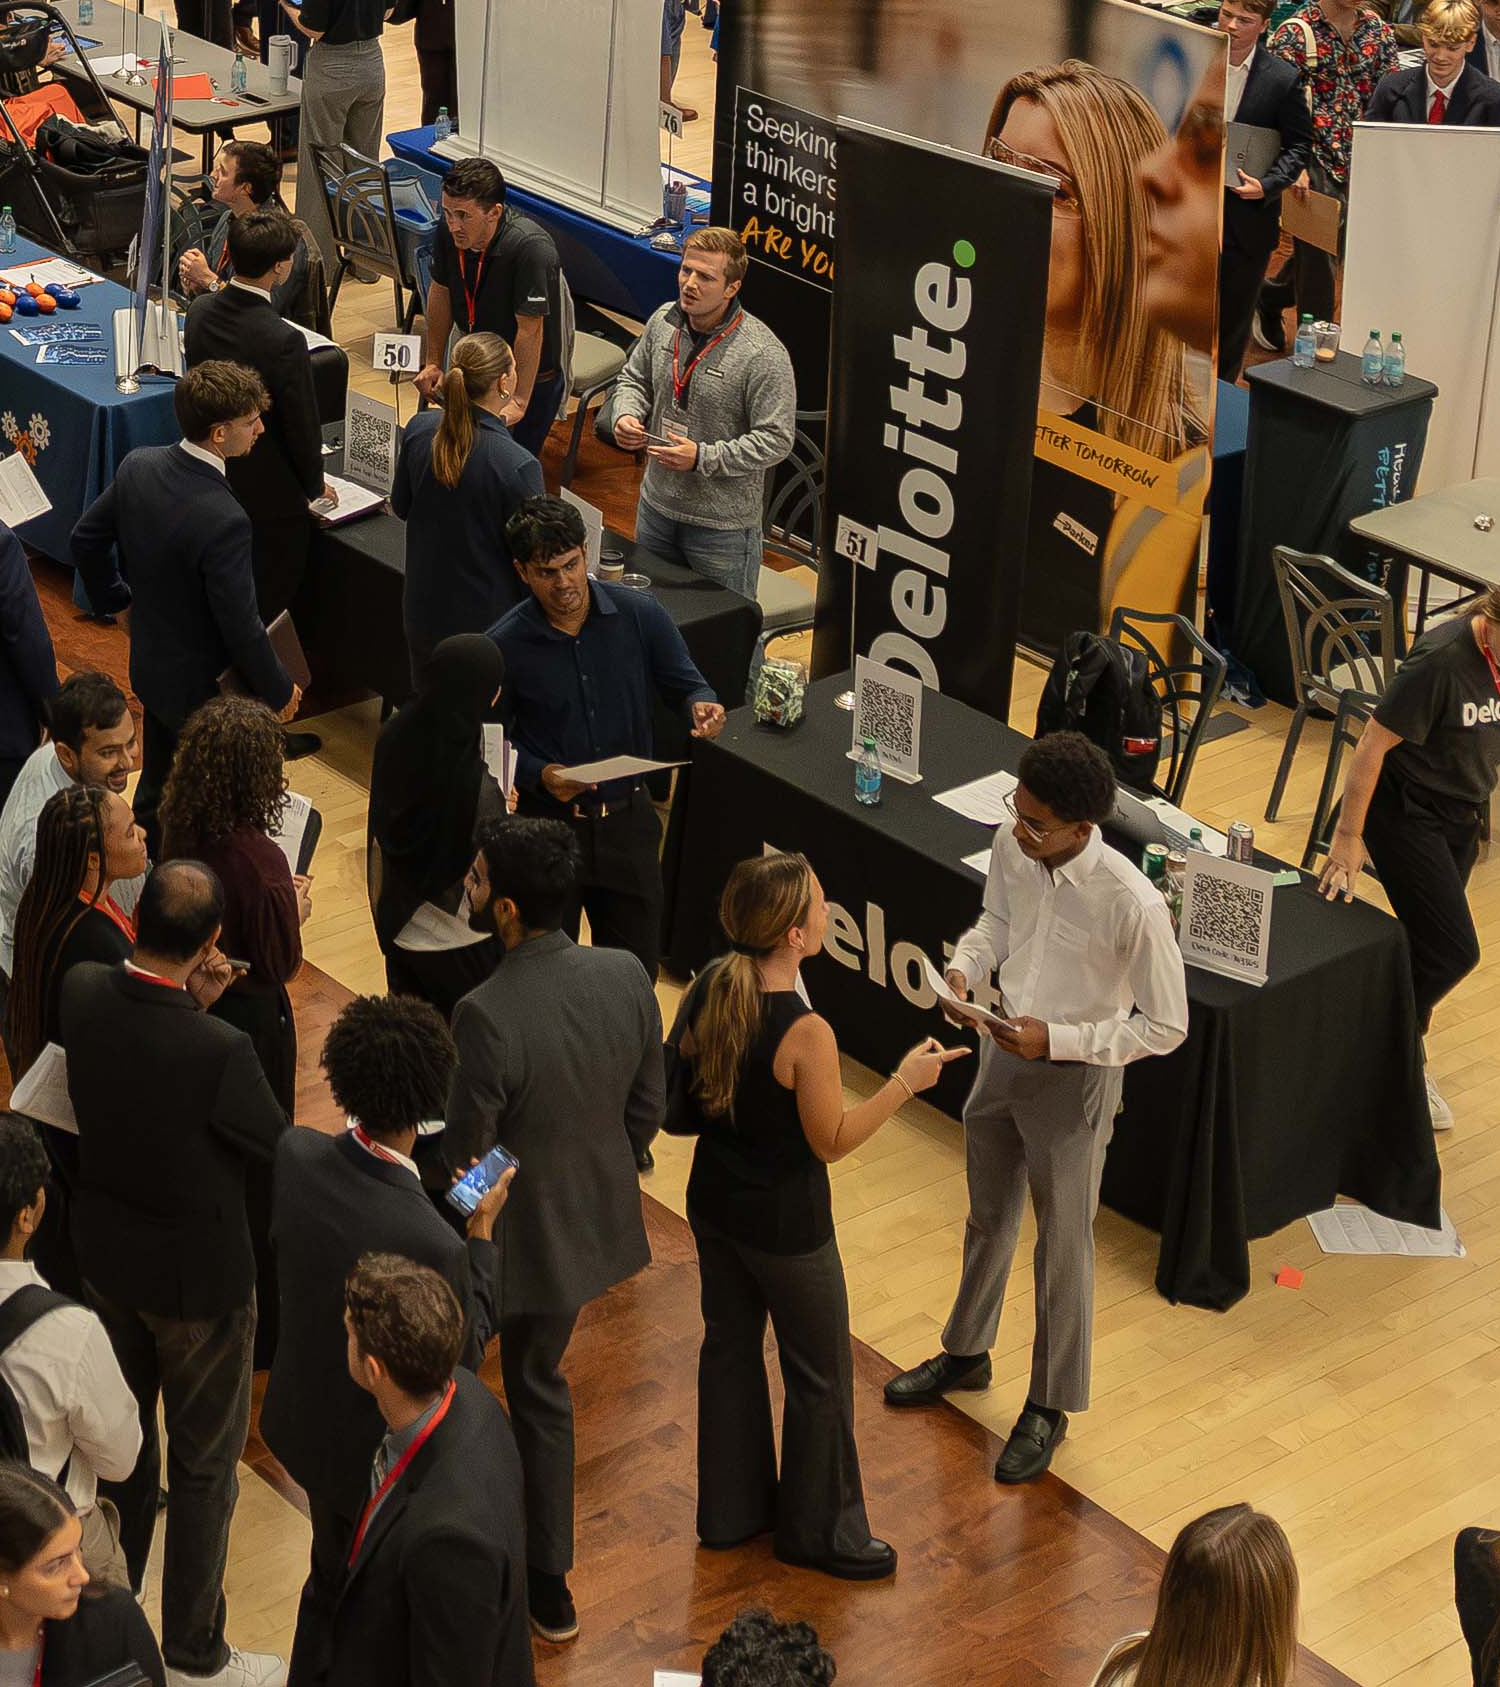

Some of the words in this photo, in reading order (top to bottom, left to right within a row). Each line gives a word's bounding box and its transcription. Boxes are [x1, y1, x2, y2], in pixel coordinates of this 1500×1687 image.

[662, 110, 678, 133] 76
[743, 179, 757, 205] a
[764, 182, 836, 240] bright
[383, 343, 411, 369] 50
[1074, 438, 1161, 490] TOMORROW
[845, 531, 868, 563] 51
[1061, 515, 1098, 554] Parker
